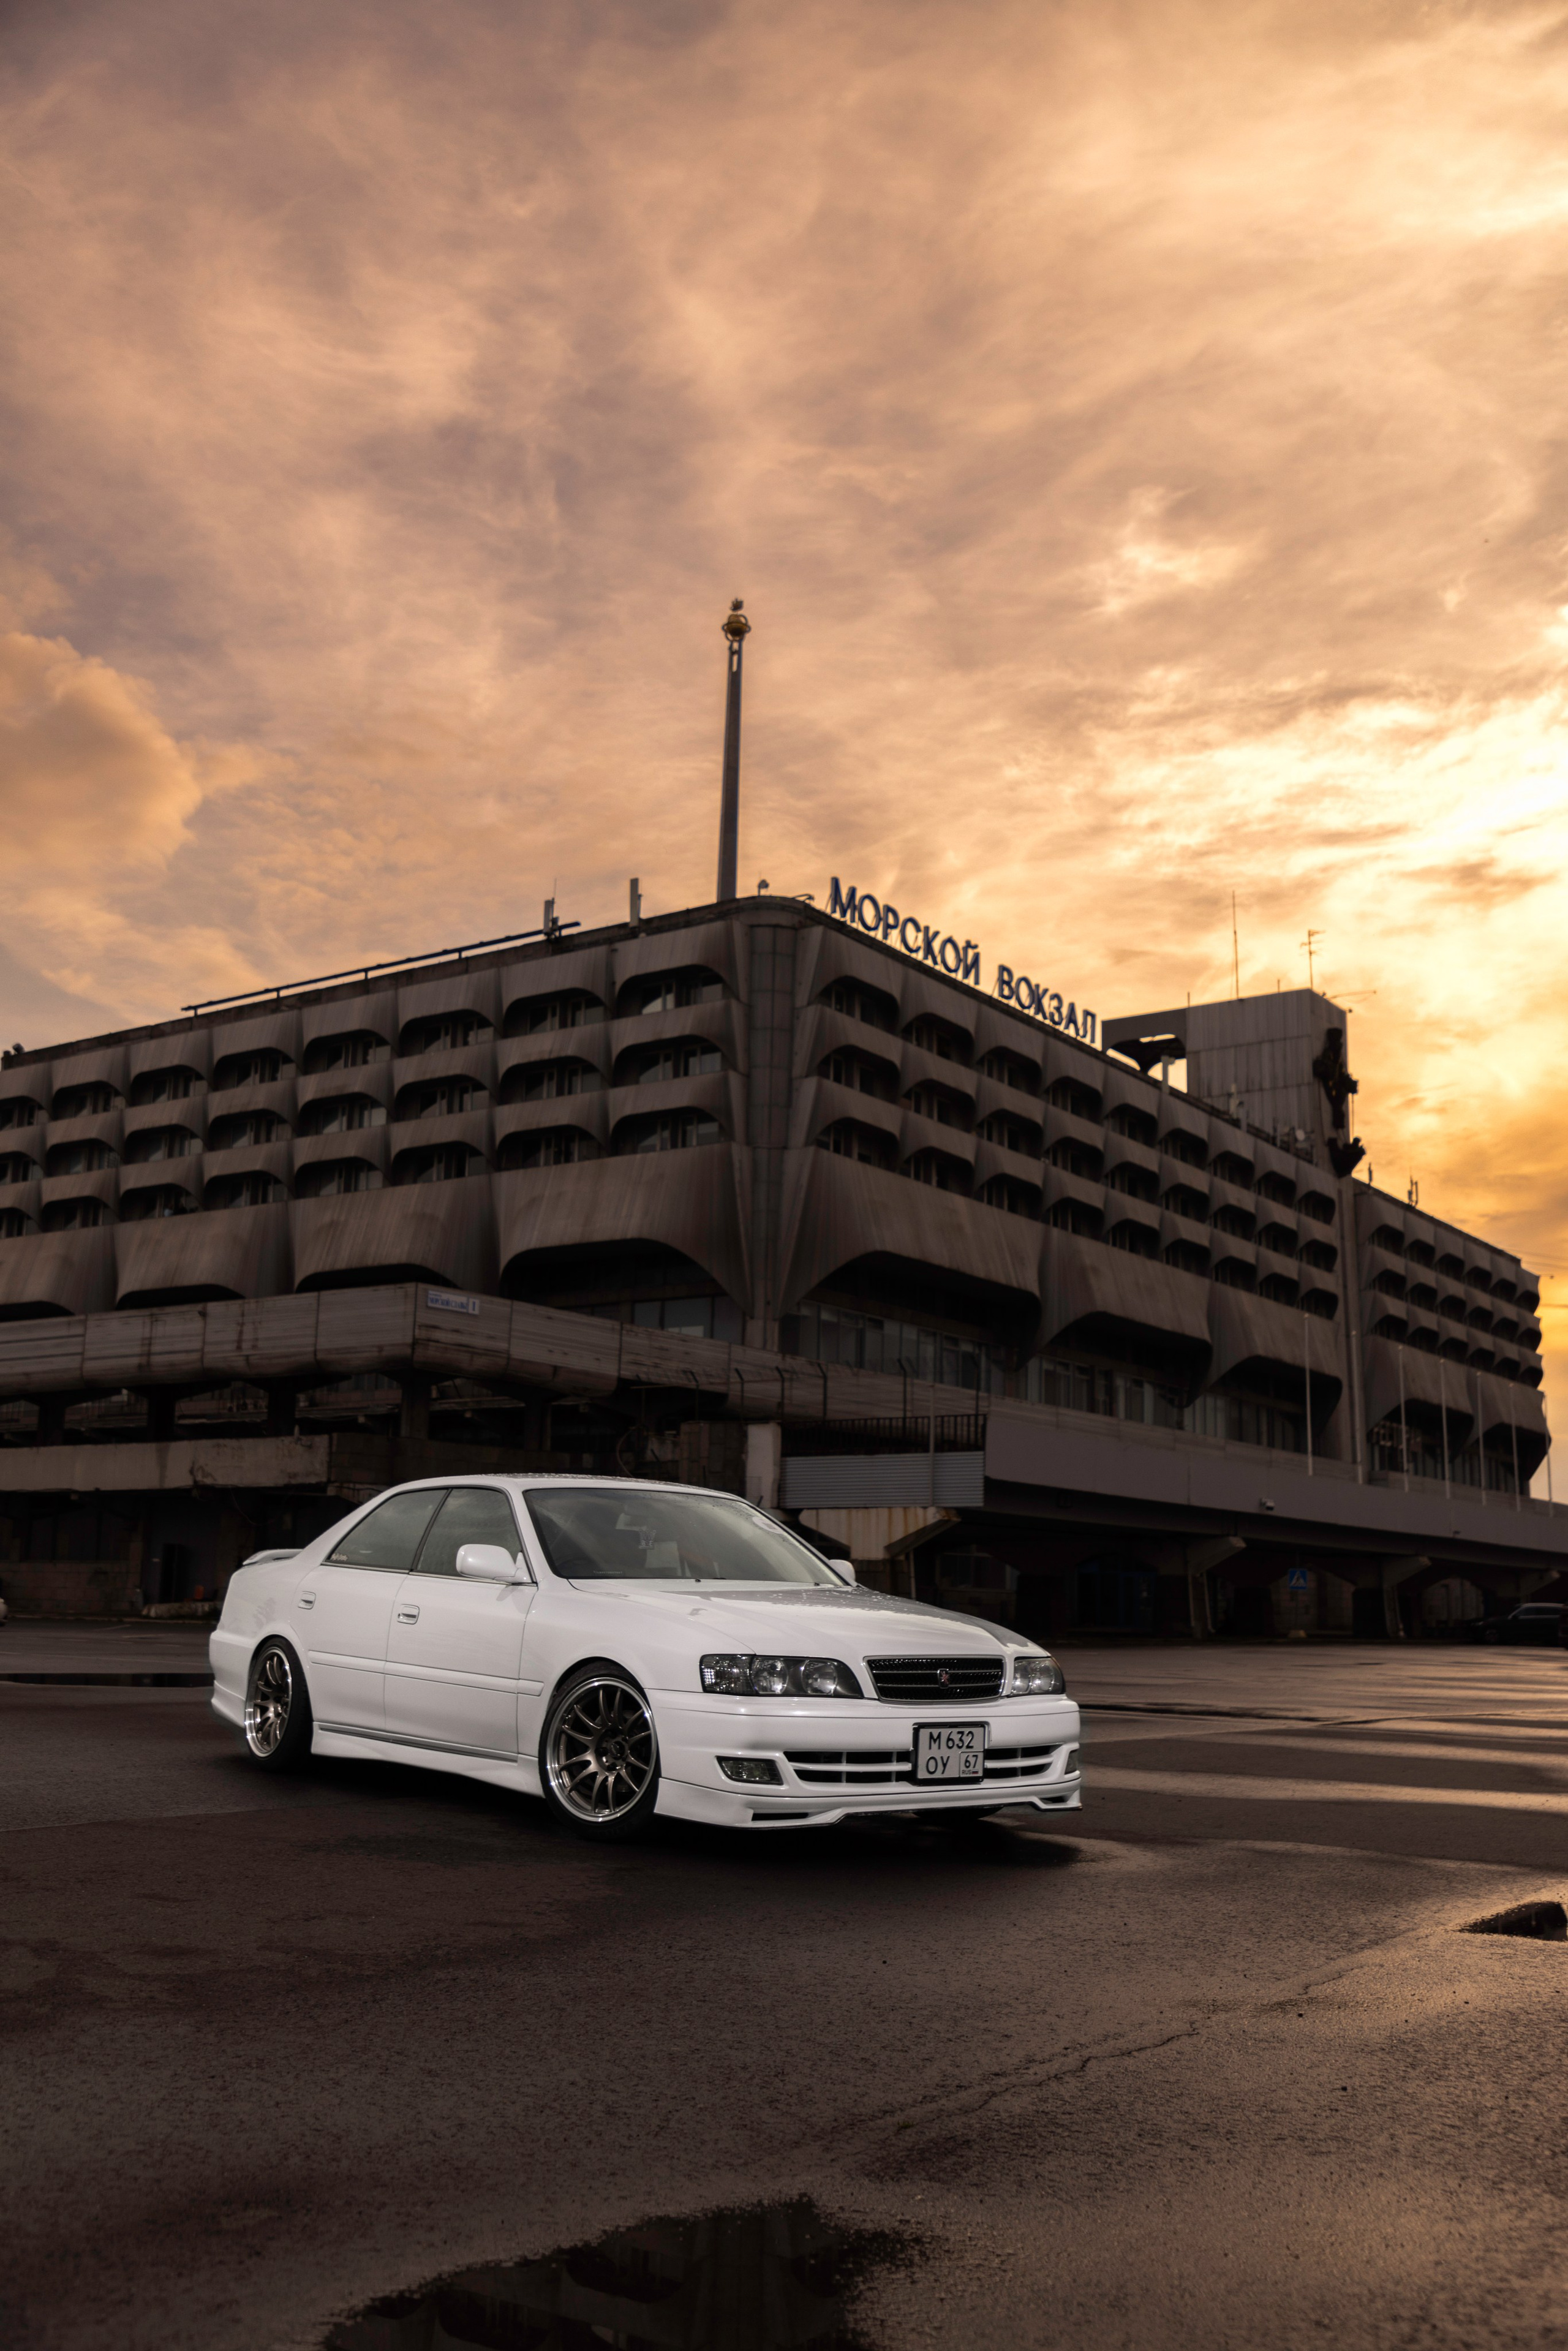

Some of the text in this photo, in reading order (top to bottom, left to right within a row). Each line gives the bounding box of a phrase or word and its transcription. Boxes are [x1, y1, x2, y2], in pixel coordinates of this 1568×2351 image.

[831, 877, 1096, 1043] МОРСКОЙ ВОКЗАЛ
[964, 1755, 978, 1768] 67
